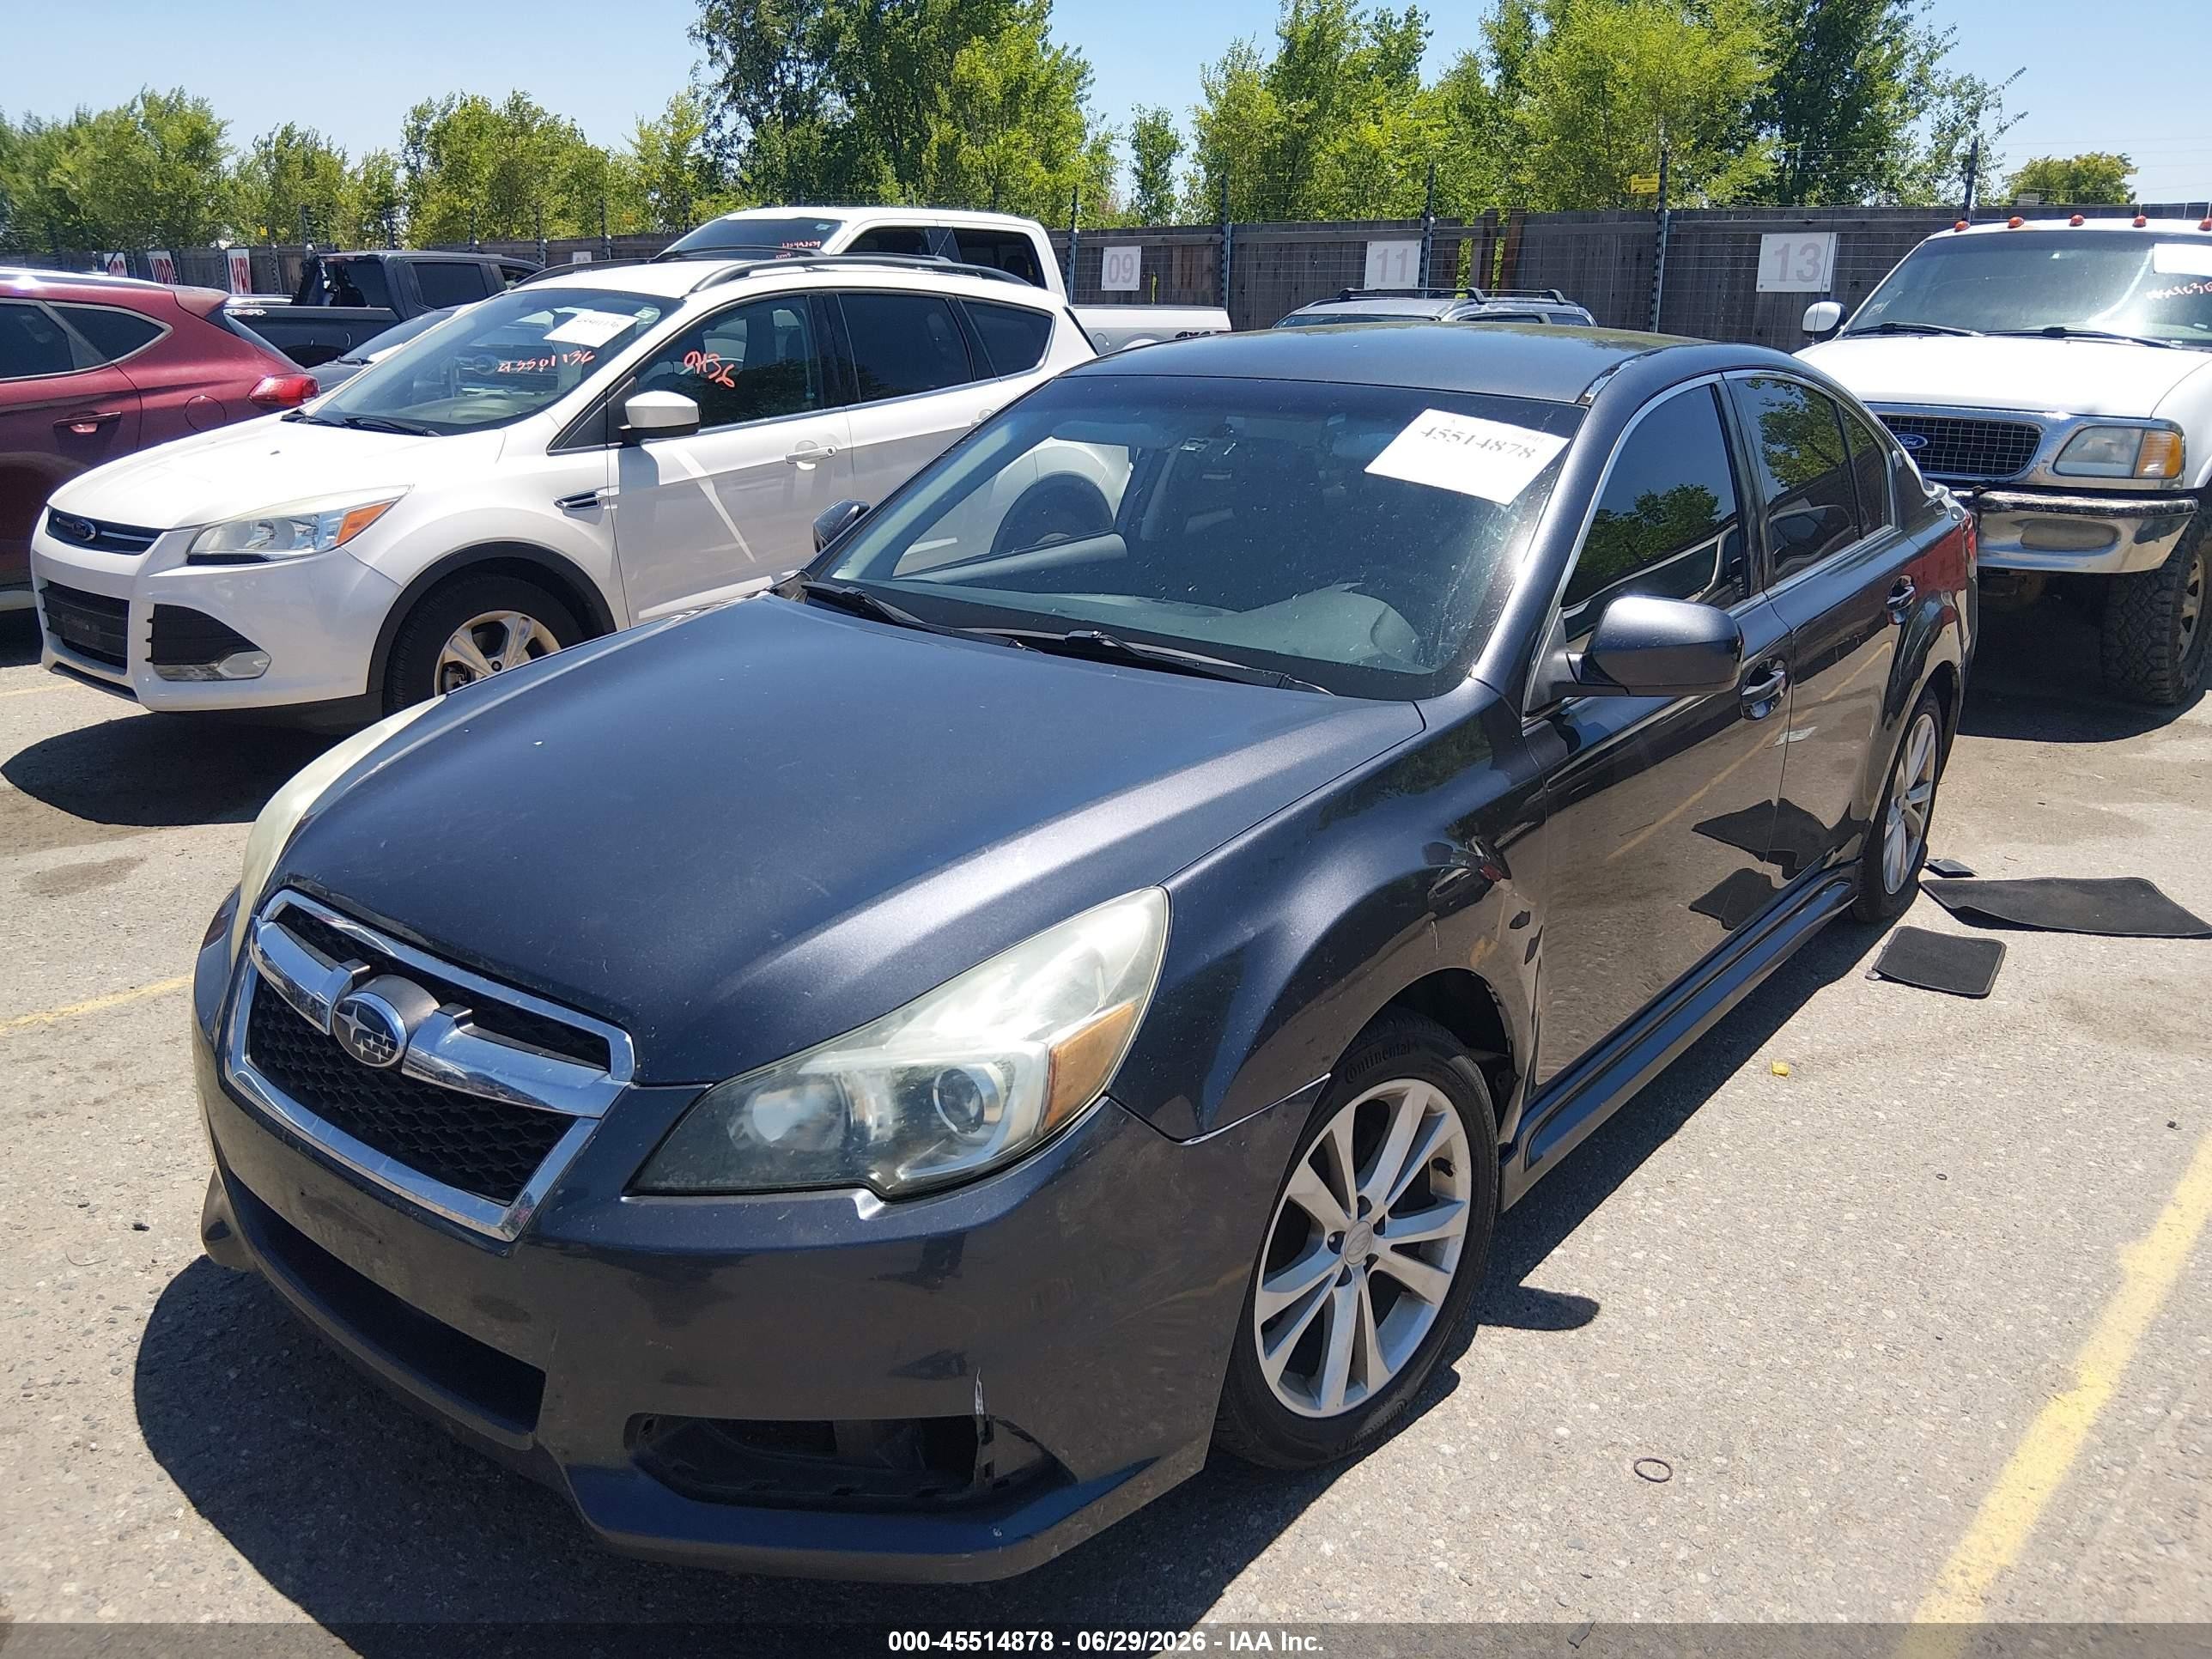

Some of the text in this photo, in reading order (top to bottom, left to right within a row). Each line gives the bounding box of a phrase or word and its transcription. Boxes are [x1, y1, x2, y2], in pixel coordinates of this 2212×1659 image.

[1108, 253, 1135, 284] 09
[1376, 247, 1408, 283] 11
[1773, 242, 1822, 283] 13
[1420, 426, 1537, 459] 45514878
[1899, 436, 1919, 446] Ford
